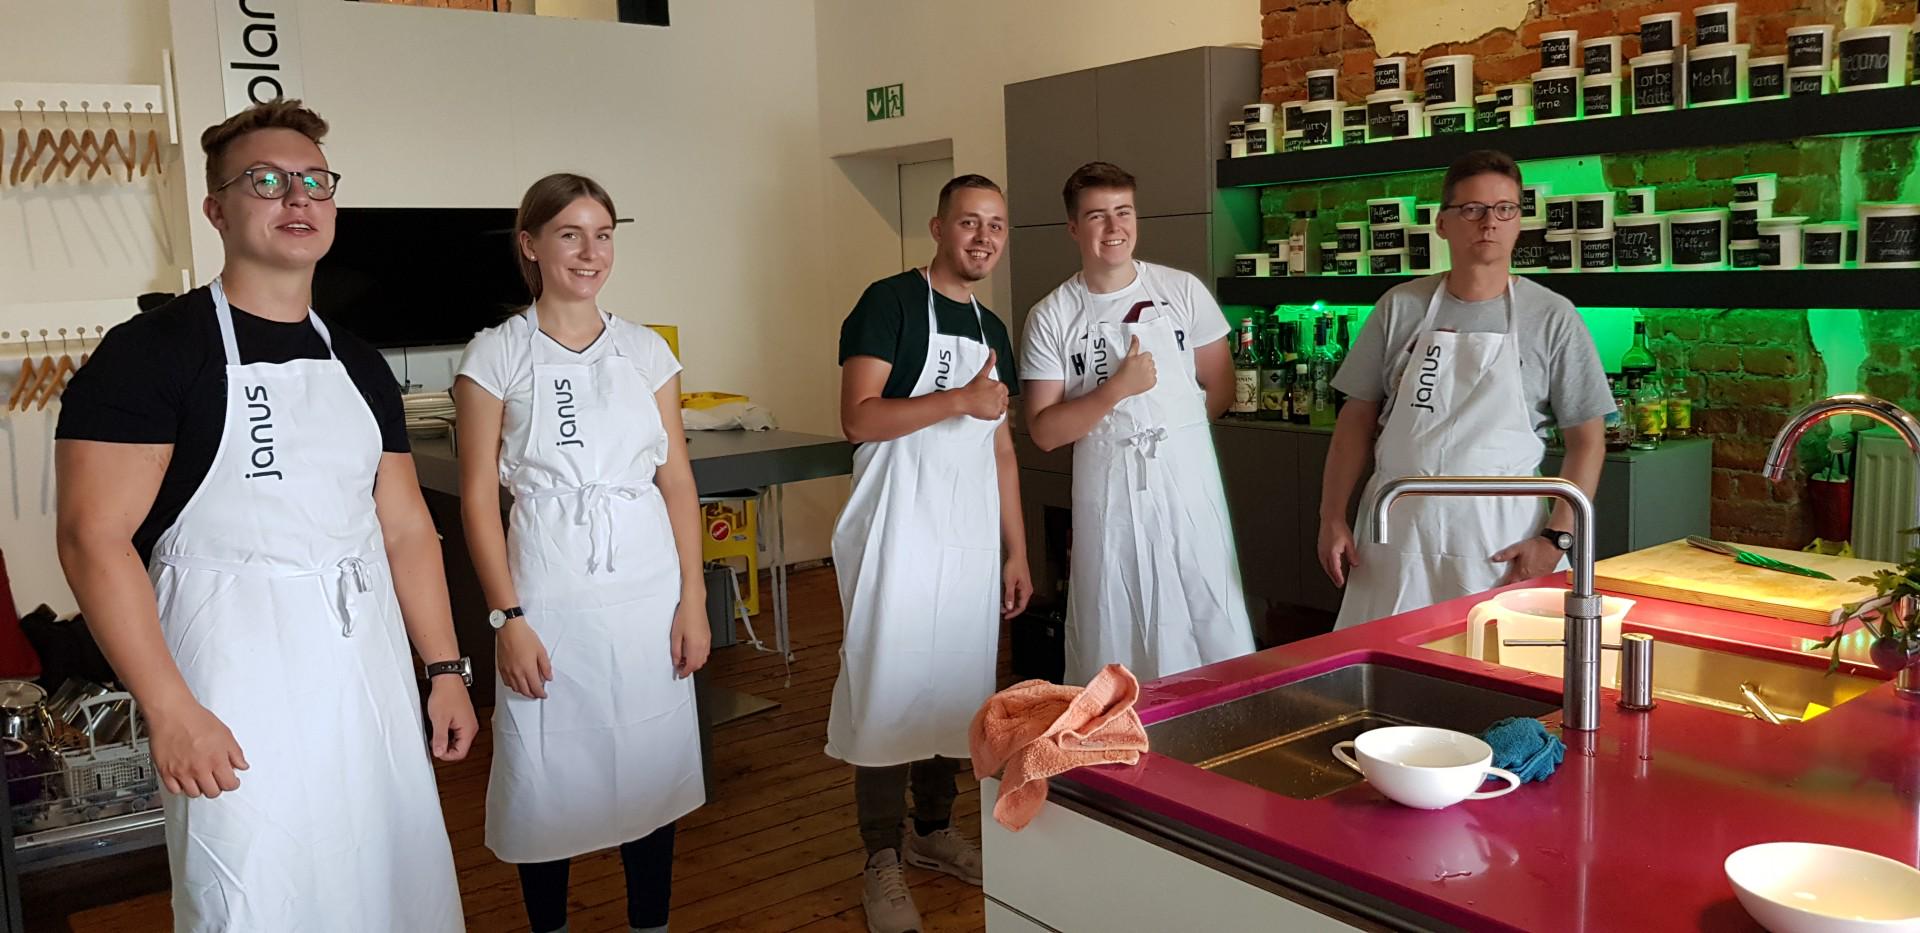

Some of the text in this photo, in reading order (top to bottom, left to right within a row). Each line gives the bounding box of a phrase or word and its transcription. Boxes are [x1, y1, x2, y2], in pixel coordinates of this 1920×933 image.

[1692, 66, 1731, 87] Mehl
[934, 349, 952, 392] nus
[1410, 344, 1441, 414] janus
[244, 385, 283, 481] janus
[554, 379, 585, 448] janus
